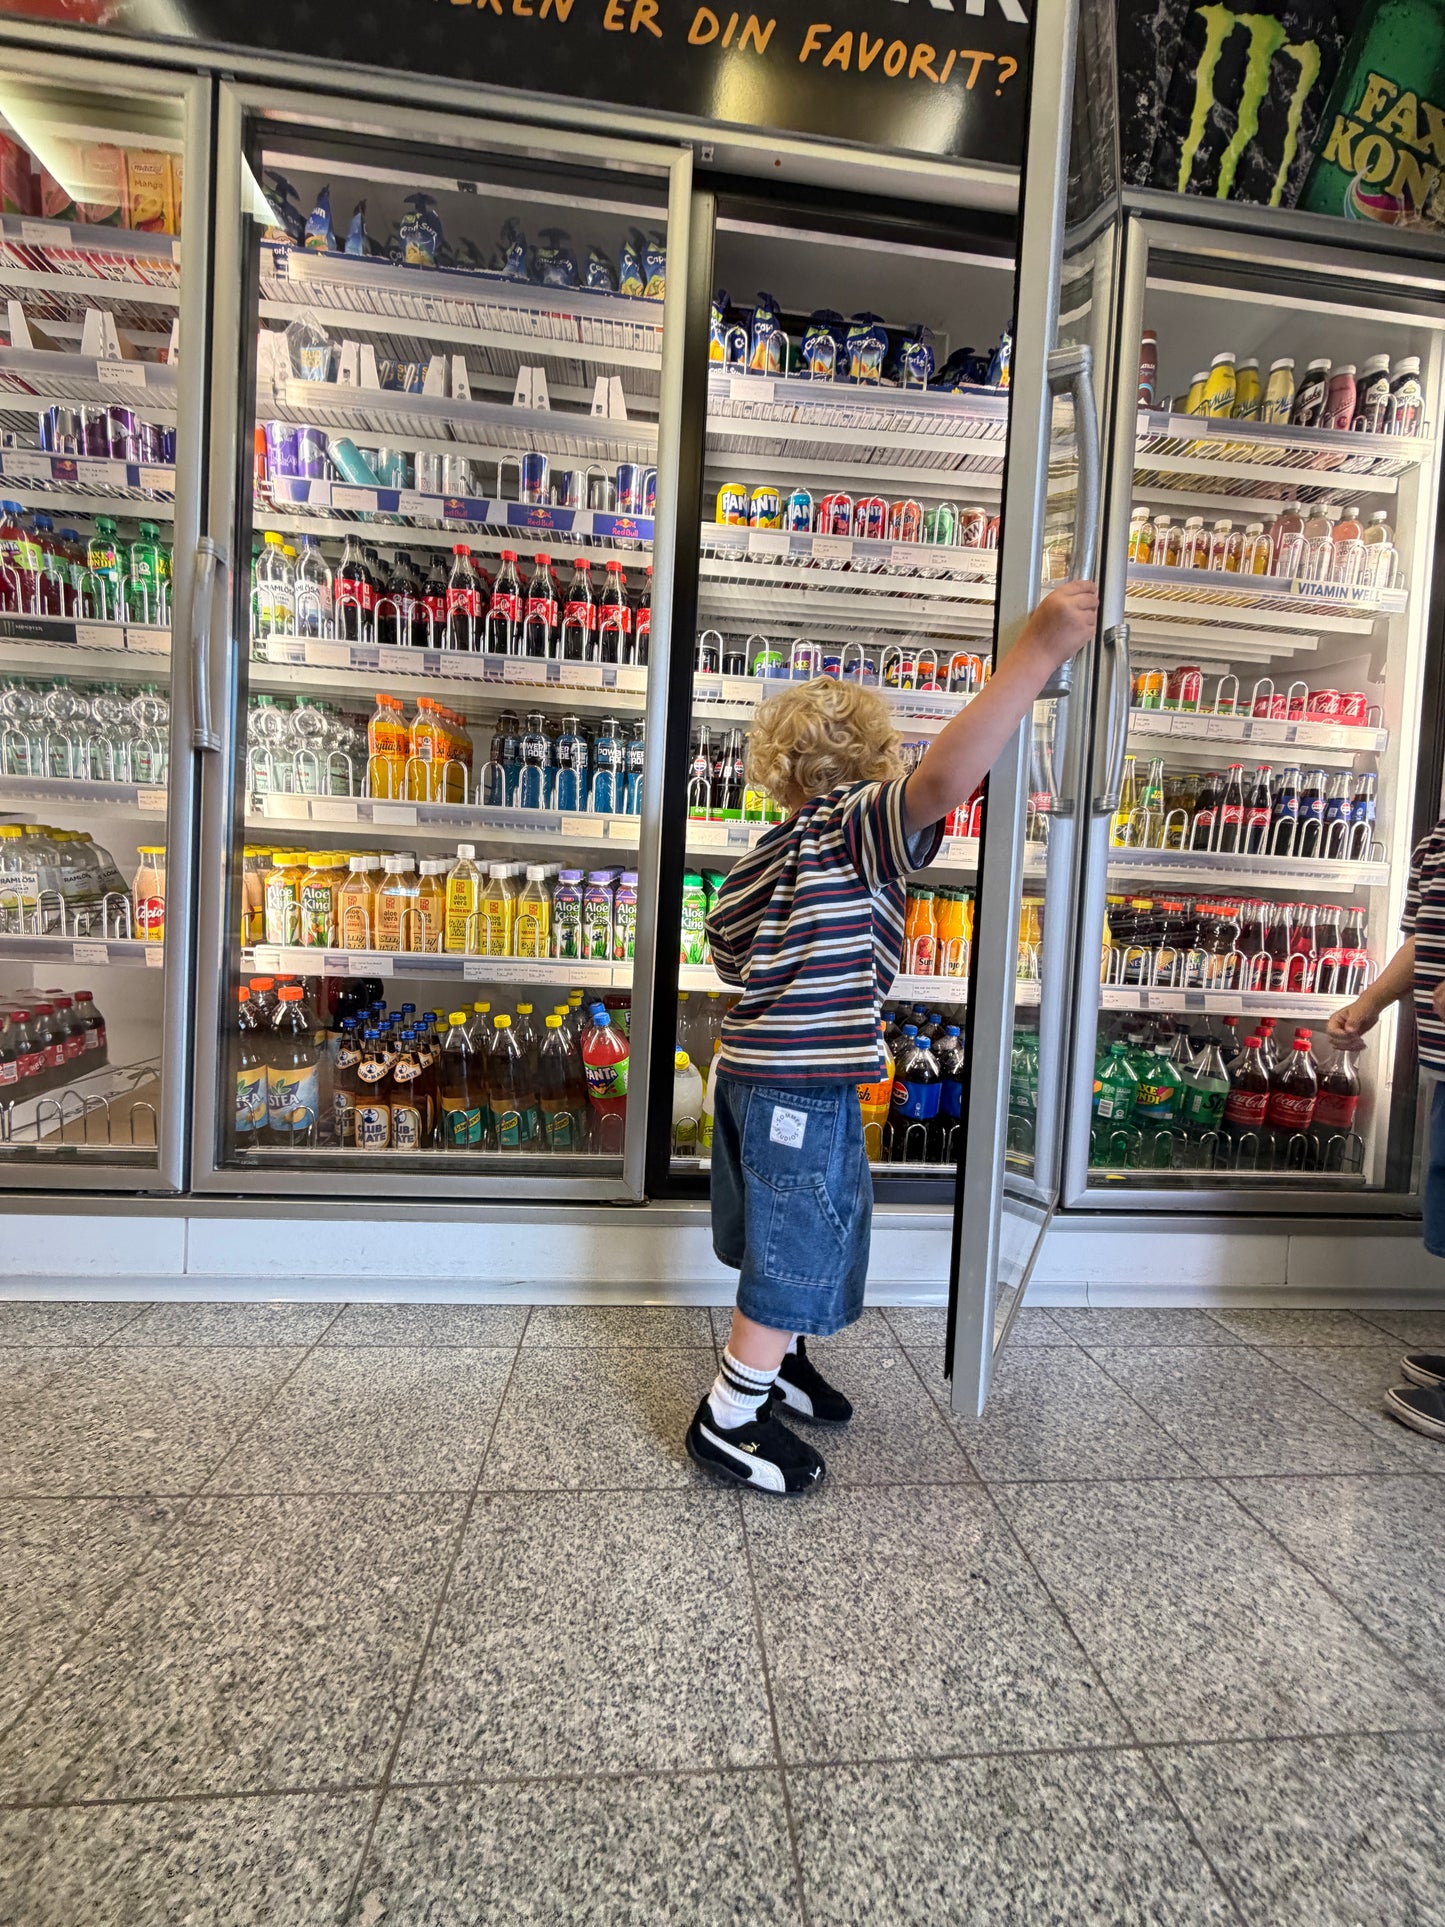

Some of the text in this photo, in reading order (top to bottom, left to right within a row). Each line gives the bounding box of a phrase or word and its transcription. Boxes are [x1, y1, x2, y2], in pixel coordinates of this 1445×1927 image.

[603, 0, 663, 38] ER
[688, 8, 776, 53] DIN
[799, 23, 1018, 96] FAVORIT?
[1322, 114, 1445, 212] KON
[1298, 582, 1380, 602] VITAMIN WELL
[303, 887, 330, 899] Aloe
[304, 899, 330, 911] King
[555, 902, 579, 912] Aloe
[585, 902, 609, 912] Aloe
[618, 904, 636, 914] Alo
[136, 905, 164, 920] Cocio
[383, 909, 398, 917] aloe
[682, 907, 704, 918] Aloe
[682, 918, 704, 930] King
[269, 1094, 300, 1108] STEA
[1271, 1092, 1316, 1113] Coca-Cola
[774, 1126, 799, 1142] STUDIOS
